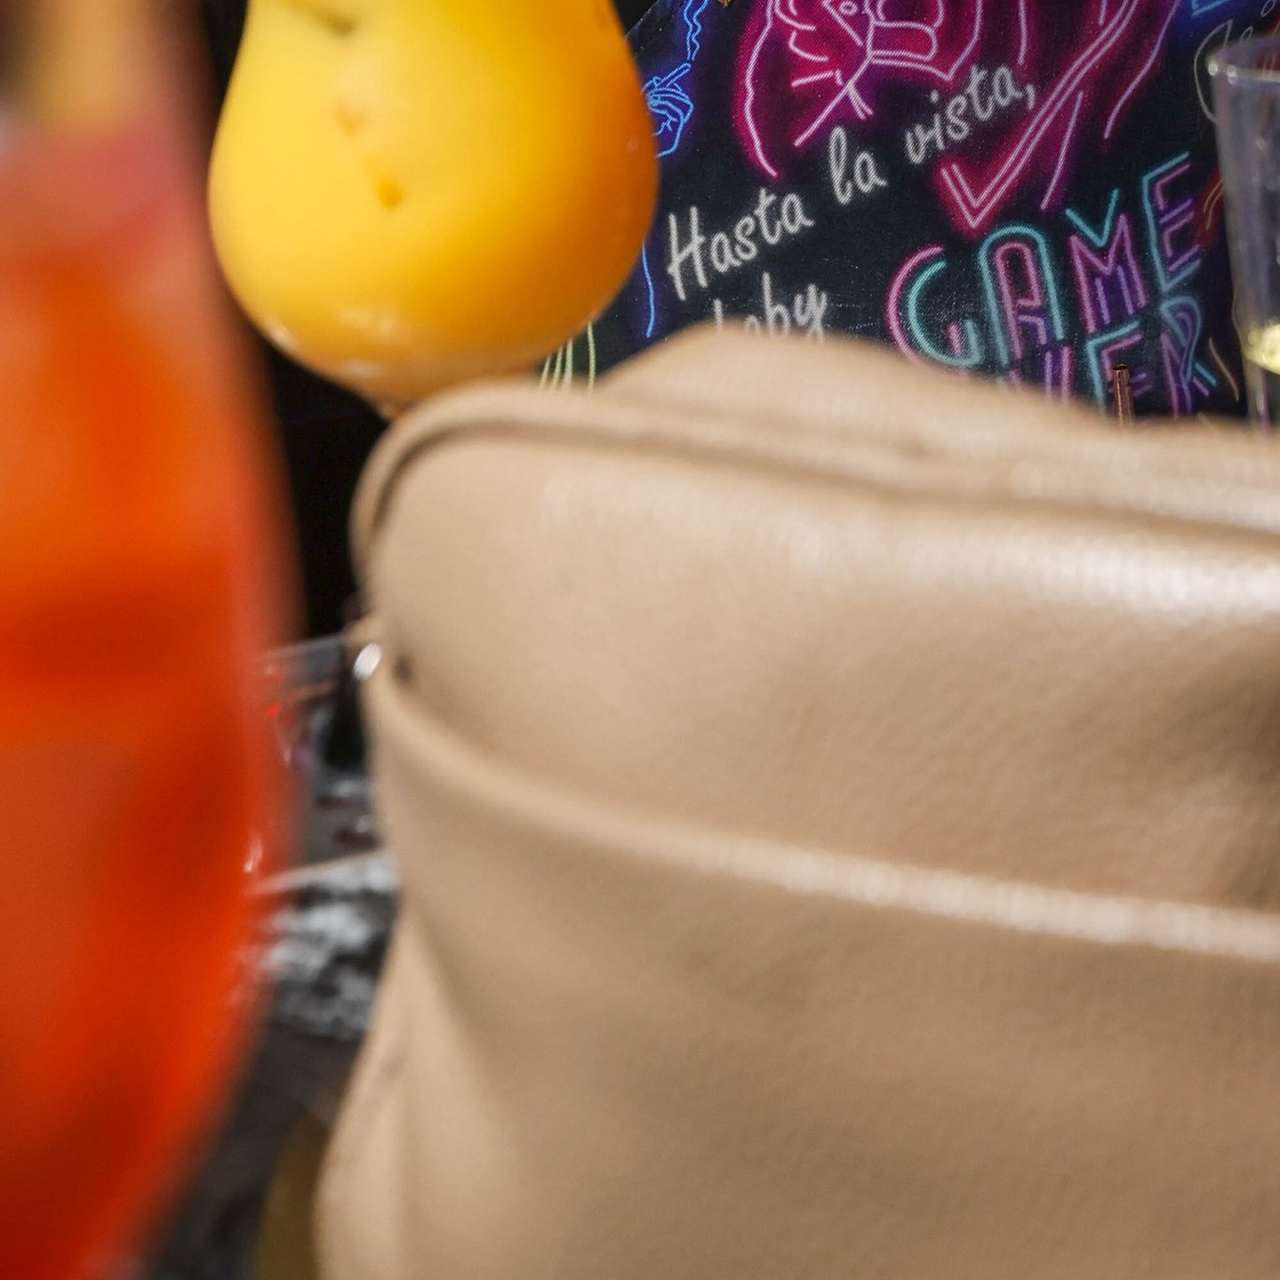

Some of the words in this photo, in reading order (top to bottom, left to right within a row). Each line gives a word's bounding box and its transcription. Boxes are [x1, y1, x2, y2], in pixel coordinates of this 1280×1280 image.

[667, 186, 816, 301] Hasta
[827, 125, 889, 205] la
[904, 64, 1036, 165] vista,
[886, 150, 1201, 370] GAME
